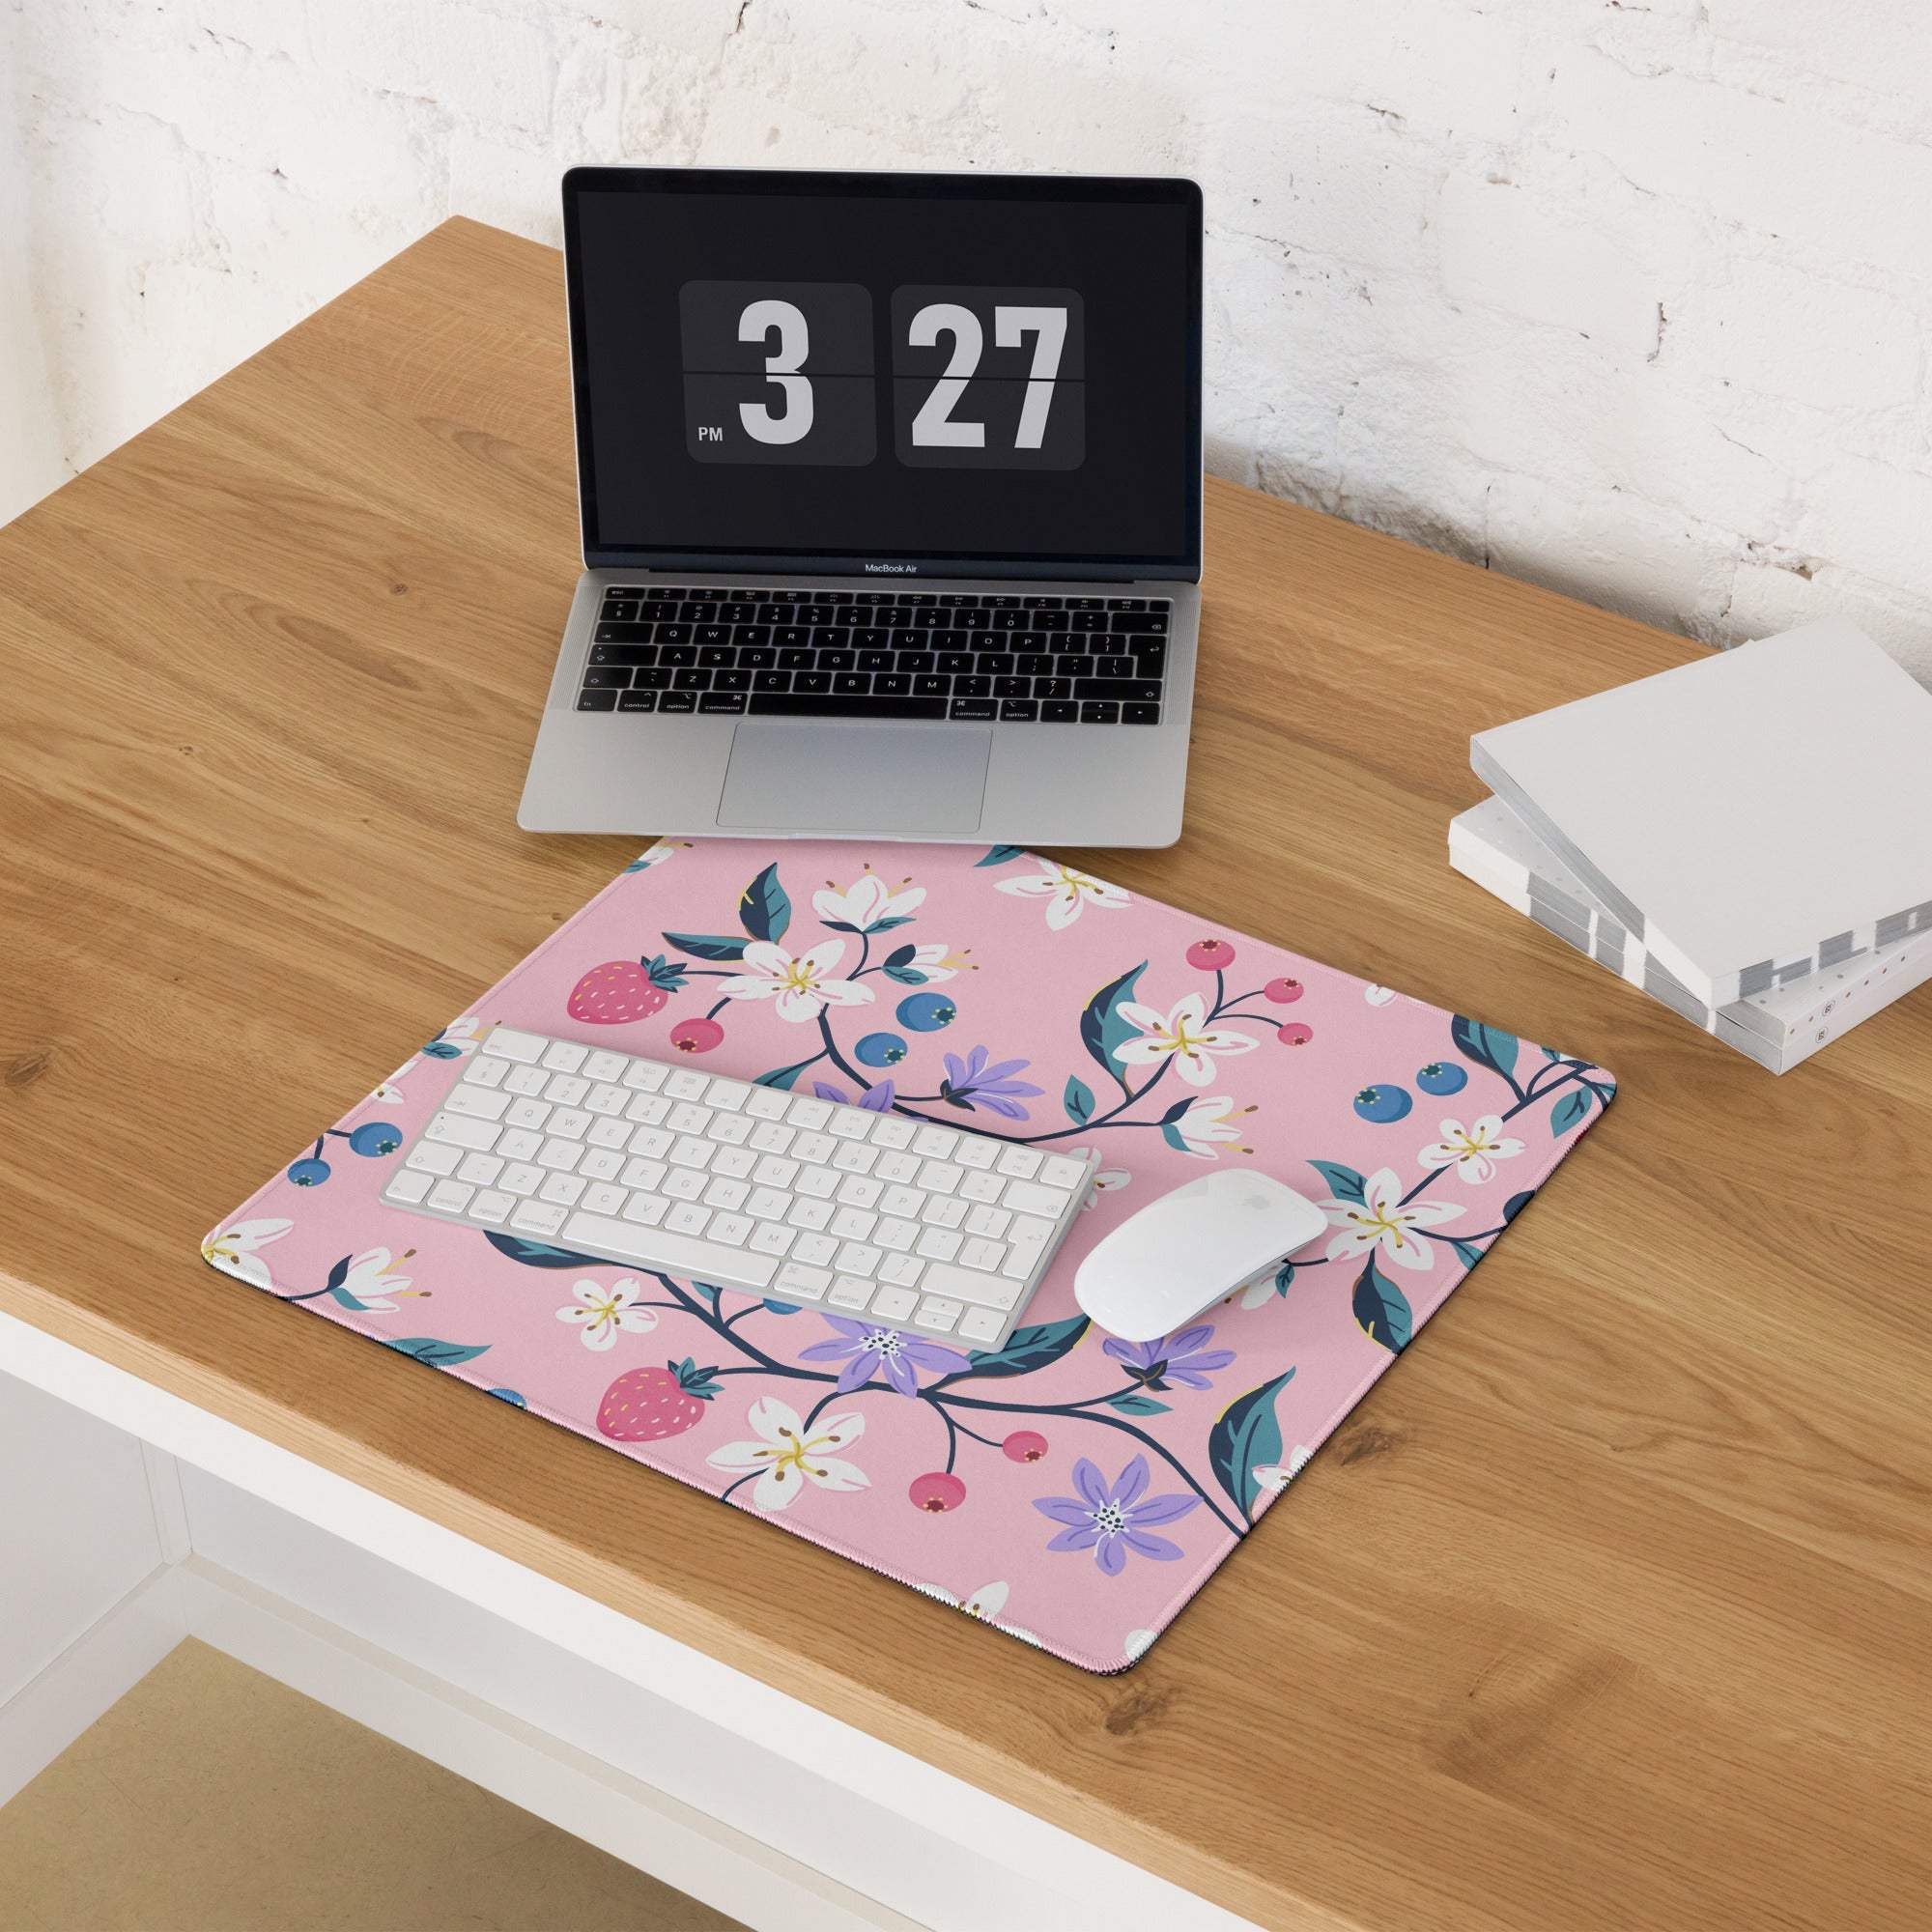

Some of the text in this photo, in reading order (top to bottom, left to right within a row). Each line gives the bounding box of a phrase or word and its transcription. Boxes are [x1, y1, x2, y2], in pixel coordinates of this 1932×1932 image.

[738, 299, 1067, 448] 3 27
[697, 427, 724, 441] PM
[906, 564, 917, 573] Air
